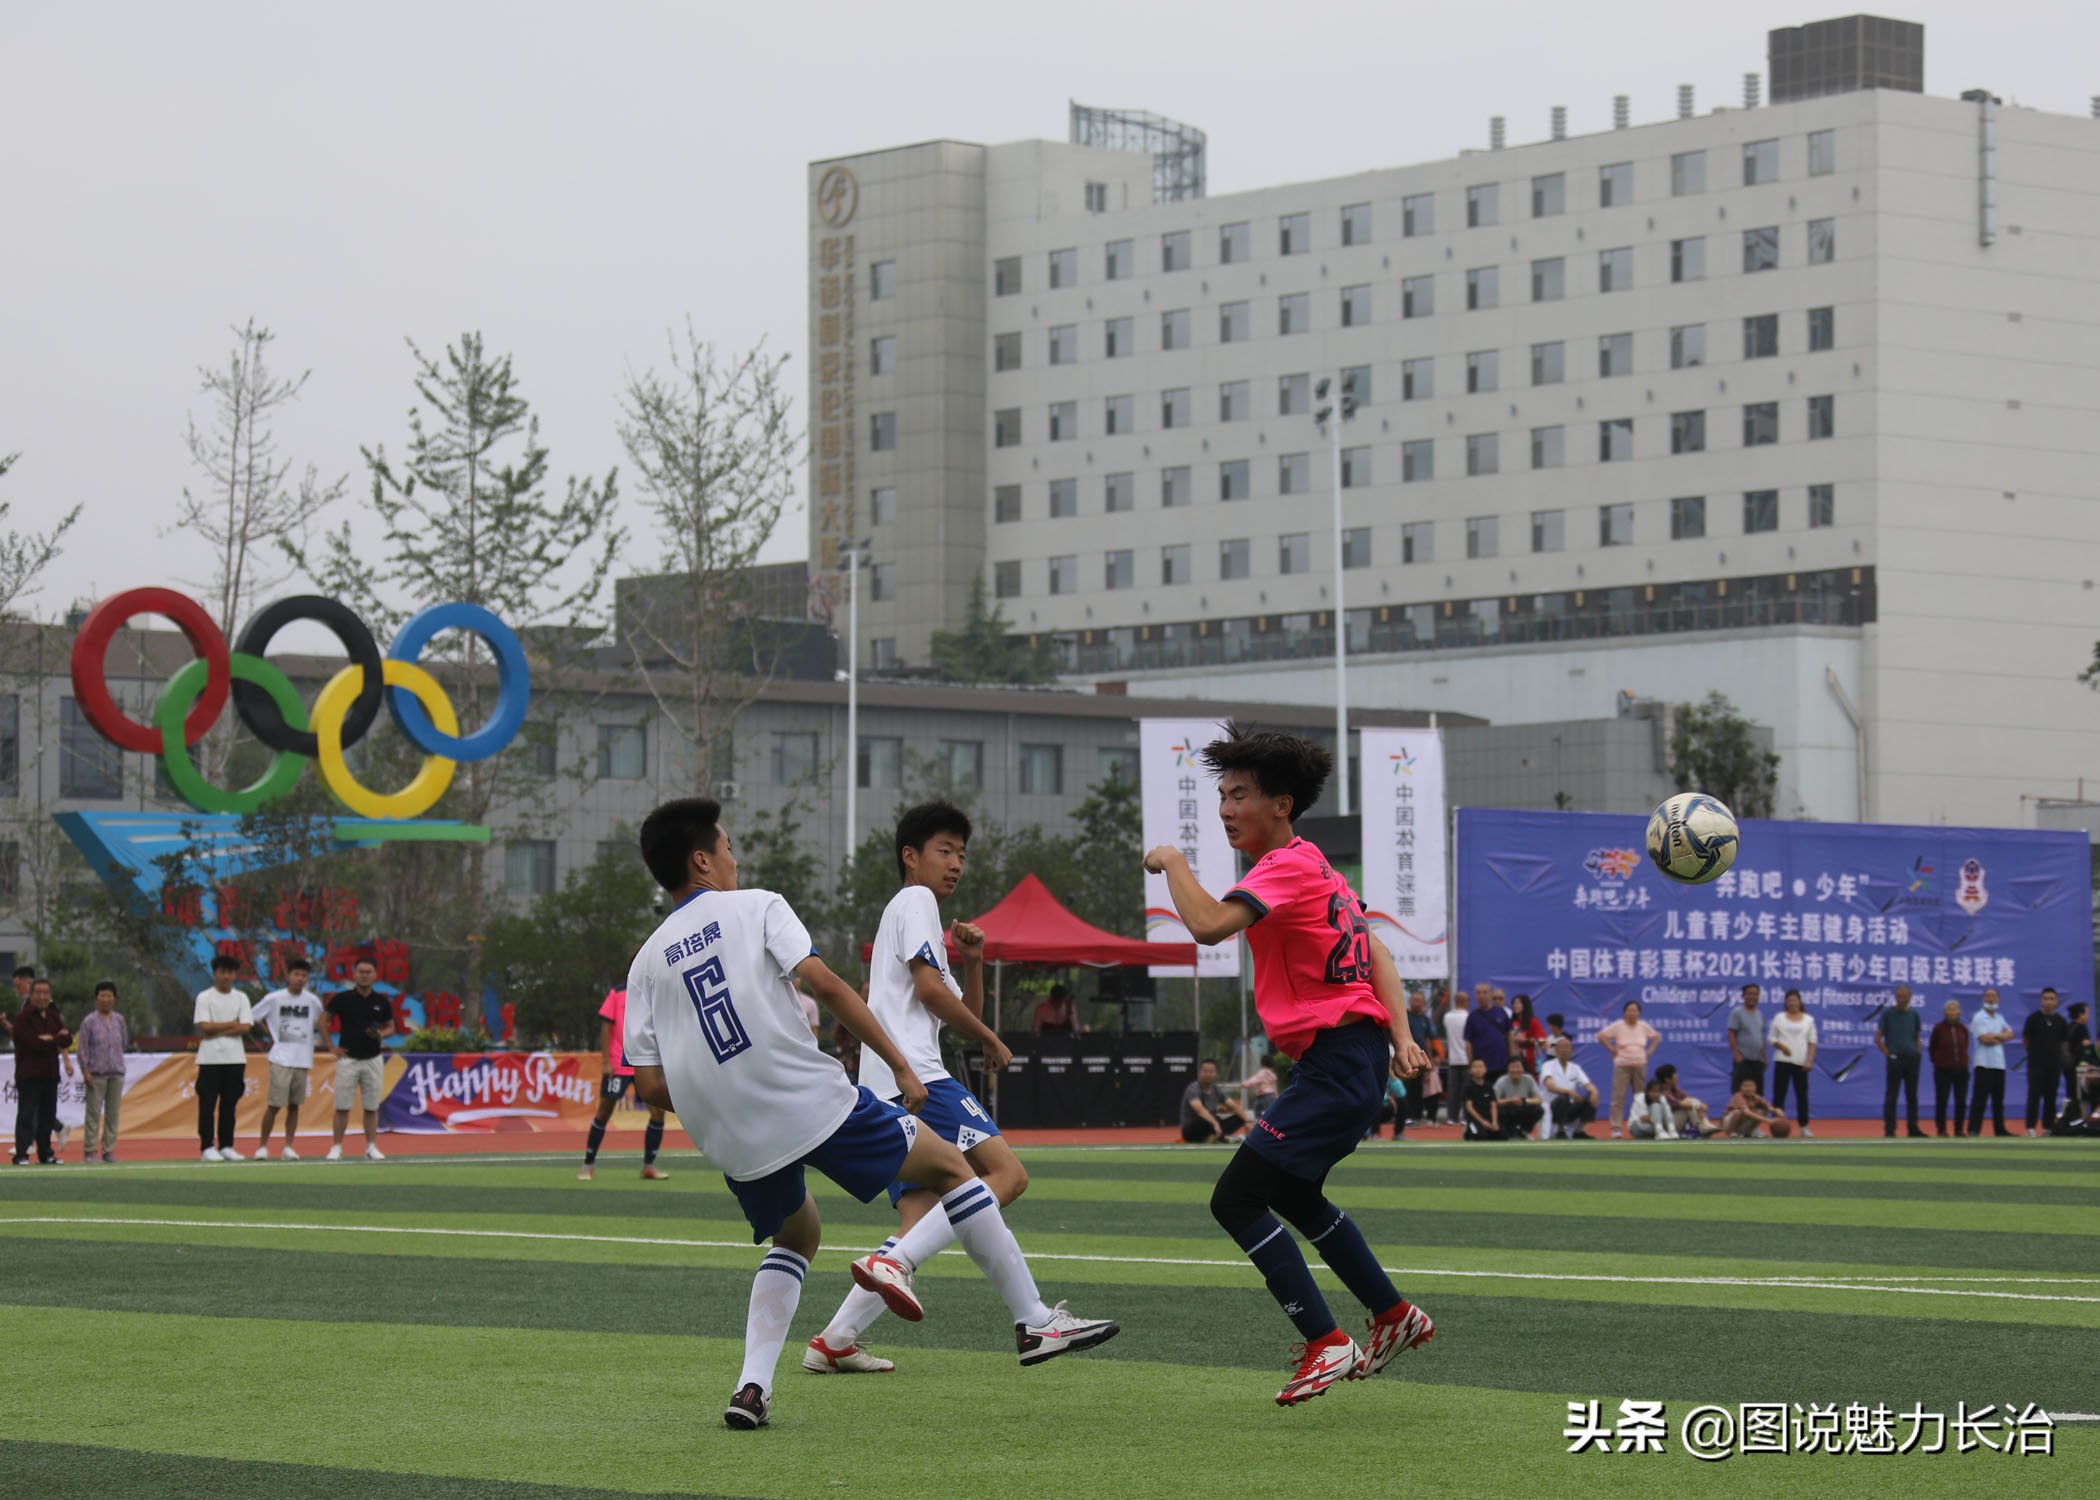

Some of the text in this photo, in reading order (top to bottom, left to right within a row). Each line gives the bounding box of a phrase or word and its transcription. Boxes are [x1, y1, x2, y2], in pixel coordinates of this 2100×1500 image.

[1671, 803, 1682, 847] molten
[663, 920, 723, 968] 高培晟
[1664, 910, 1909, 945] 儿童青少年主题健身活动
[1547, 948, 2015, 987] 中国体育彩票杯2021长治市青少年四级足球联赛
[682, 955, 752, 1065] 6
[1641, 986, 1697, 1004] Children
[1700, 986, 1727, 1004] and
[1822, 987, 1863, 1009] fitness
[408, 1051, 595, 1115] Happy Run
[607, 1078, 621, 1094] 19
[961, 1096, 988, 1123] 4
